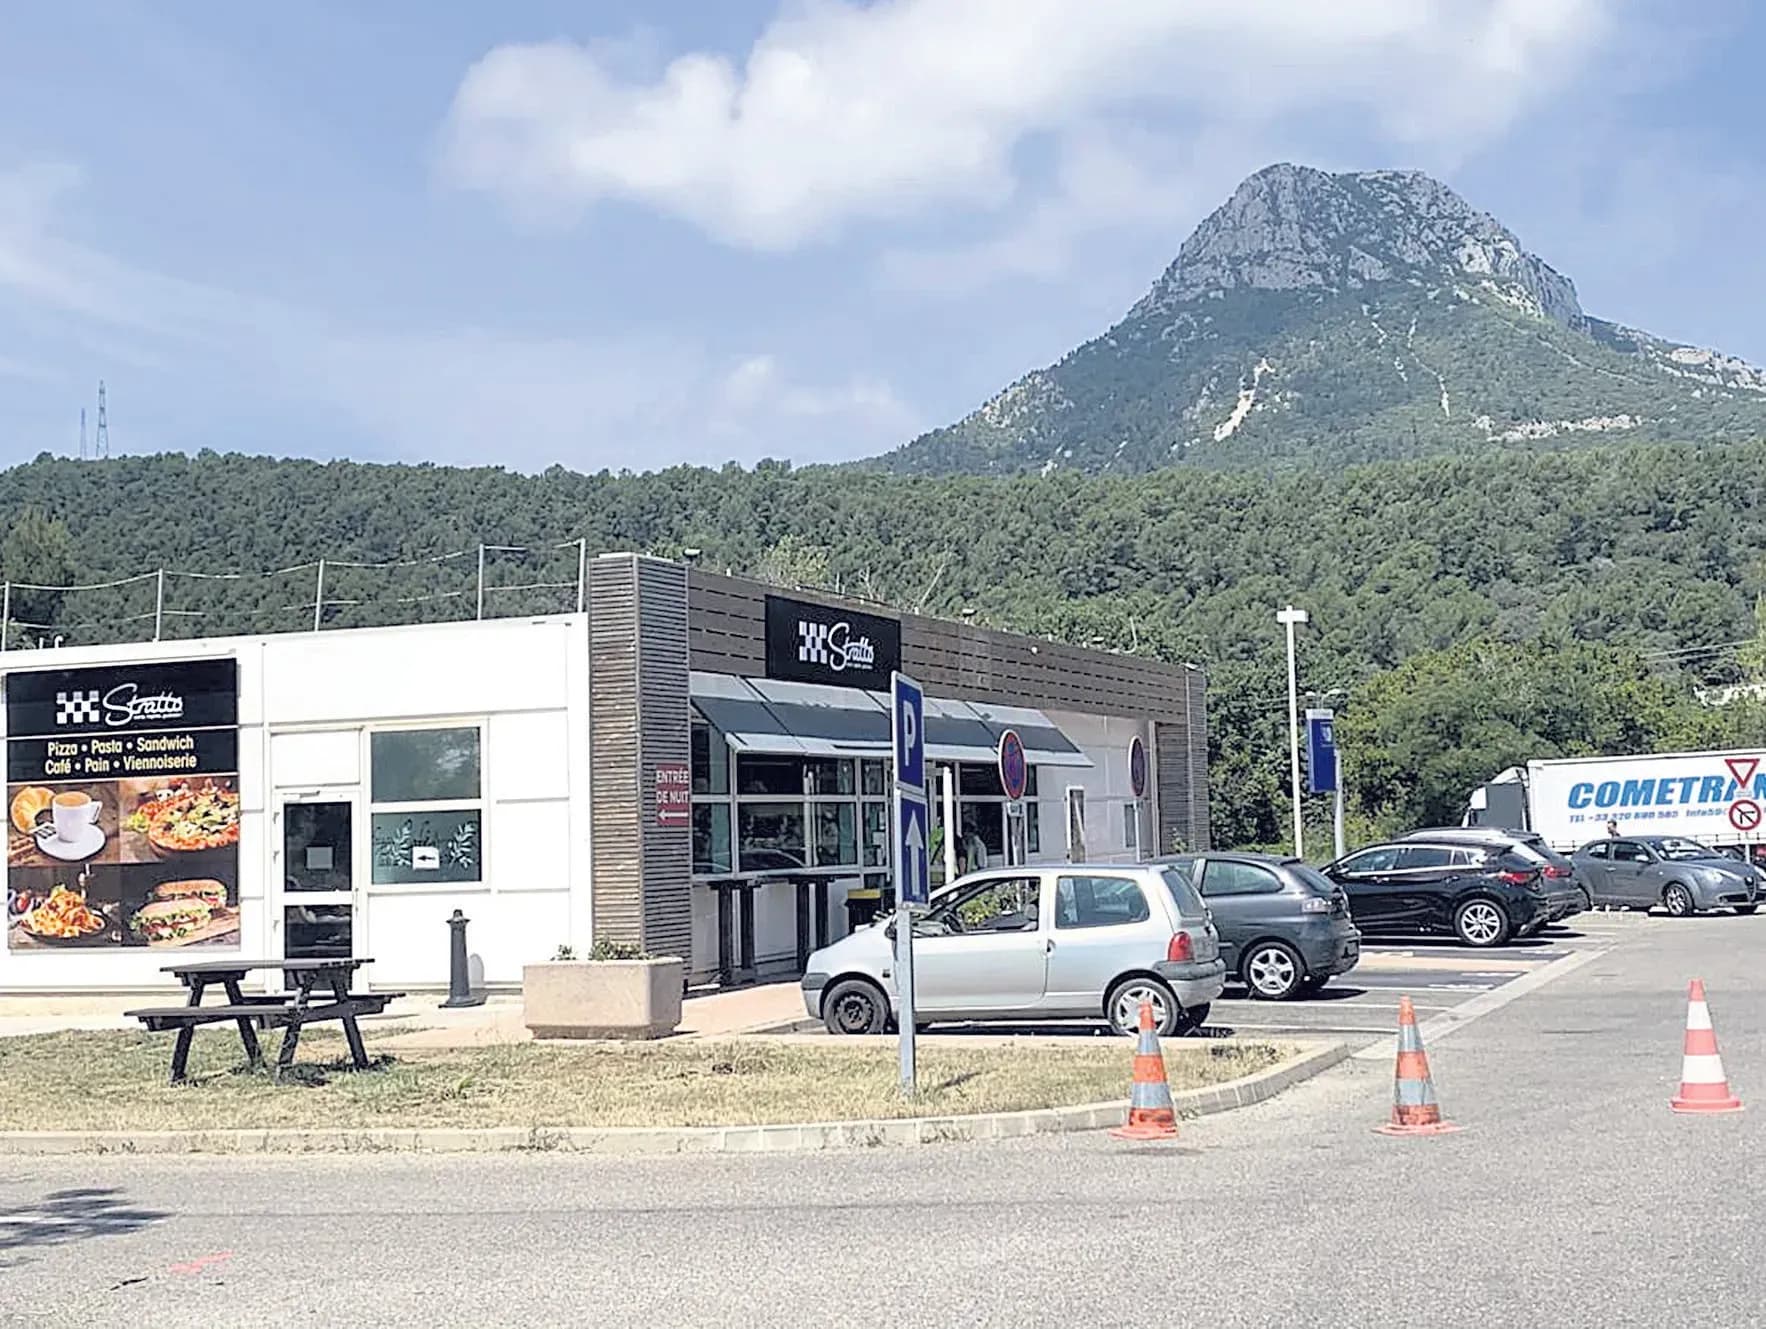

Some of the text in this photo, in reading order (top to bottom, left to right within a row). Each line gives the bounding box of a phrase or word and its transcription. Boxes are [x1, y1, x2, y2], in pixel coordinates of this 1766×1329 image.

[103, 683, 183, 726] Stratto
[903, 700, 916, 767] P
[47, 735, 194, 757] Pizza Pasta Sandwich
[45, 753, 197, 775] Café Pain Viennoiserie
[656, 767, 689, 784] ENTRÉE
[656, 790, 689, 804] DE NUIT
